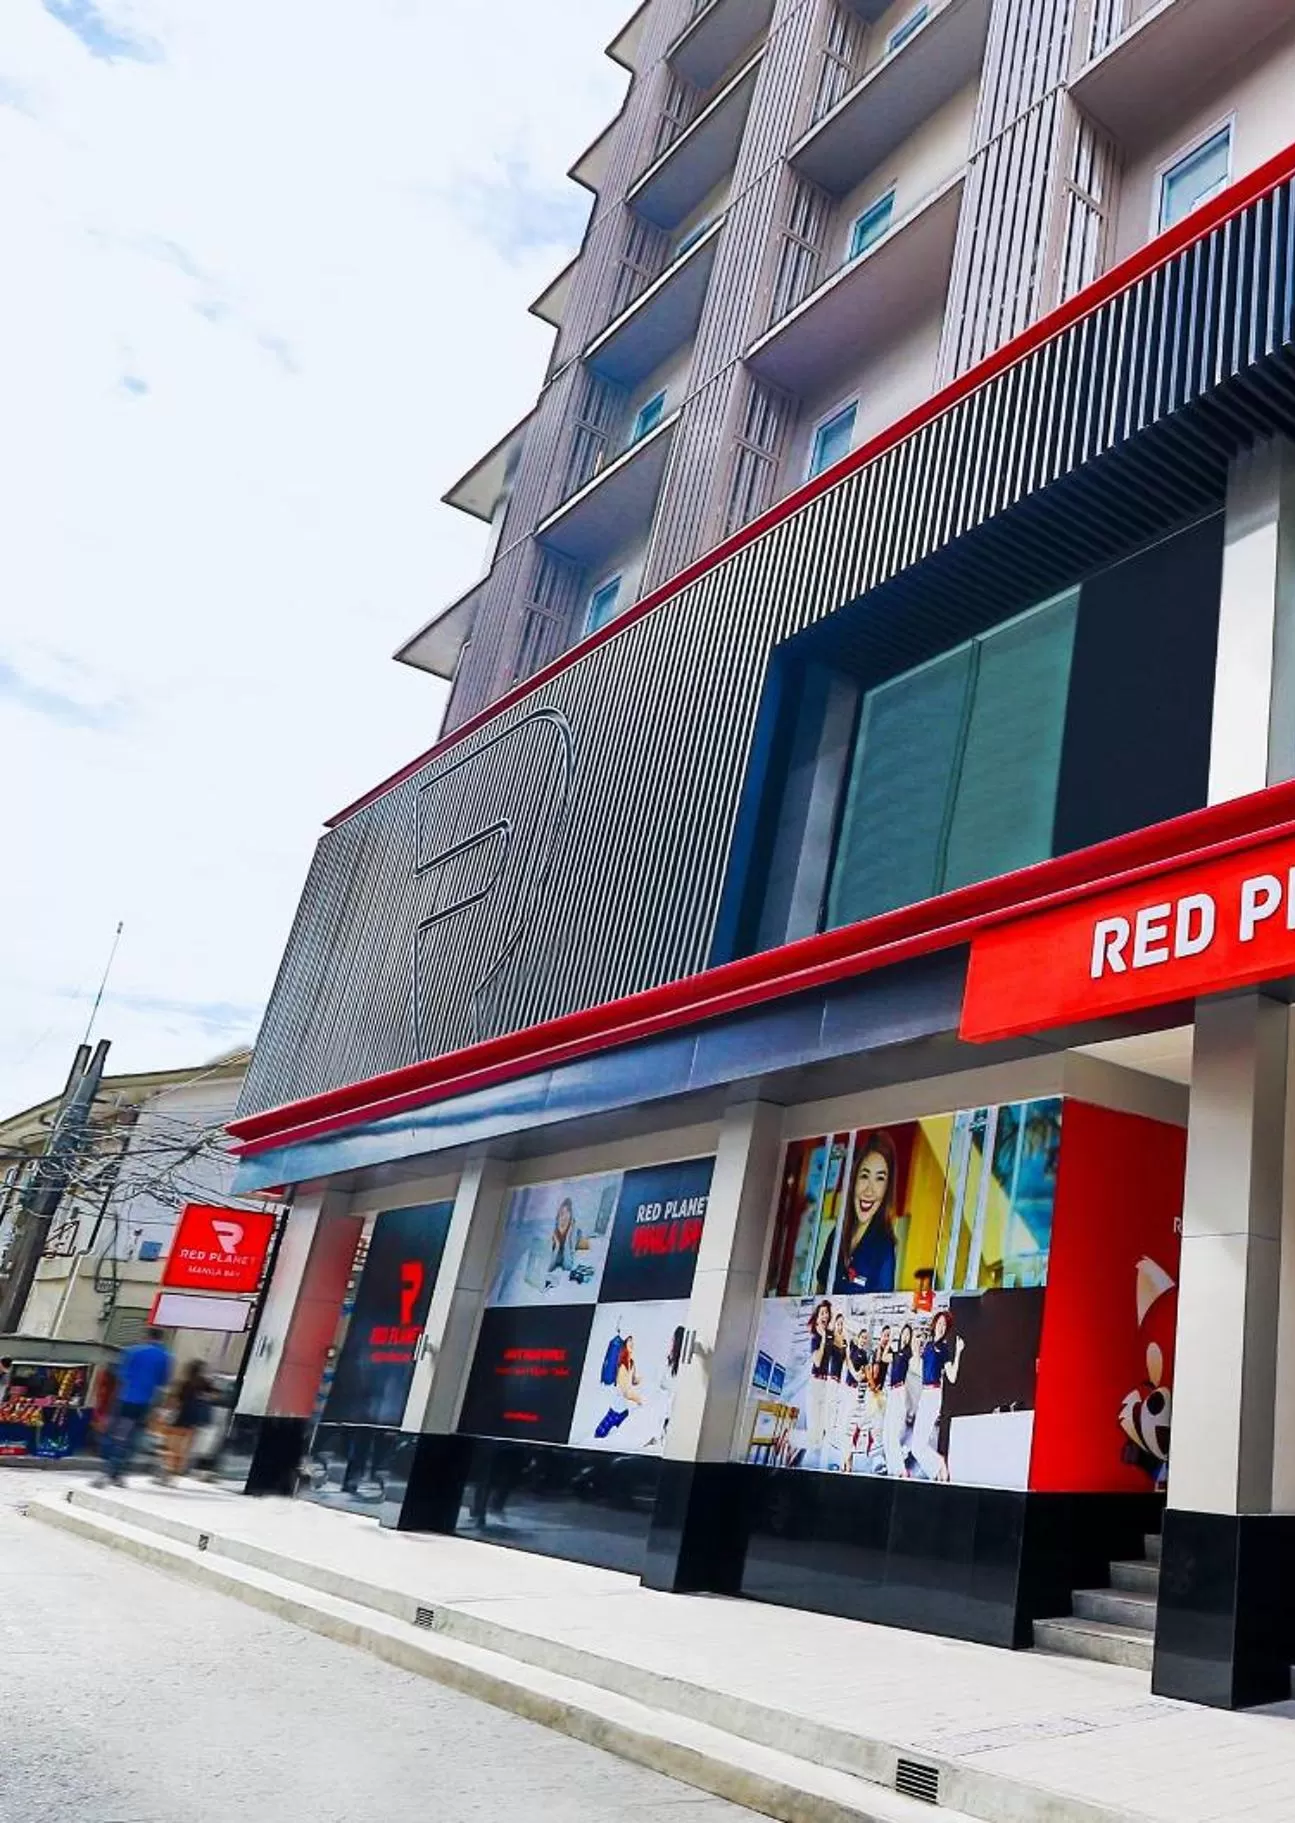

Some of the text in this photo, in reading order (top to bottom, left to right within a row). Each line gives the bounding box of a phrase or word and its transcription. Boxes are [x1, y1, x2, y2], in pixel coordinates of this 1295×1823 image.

[1090, 892, 1216, 979] RED
[636, 1195, 709, 1224] RED PLANE
[179, 1248, 256, 1266] RED PLANET
